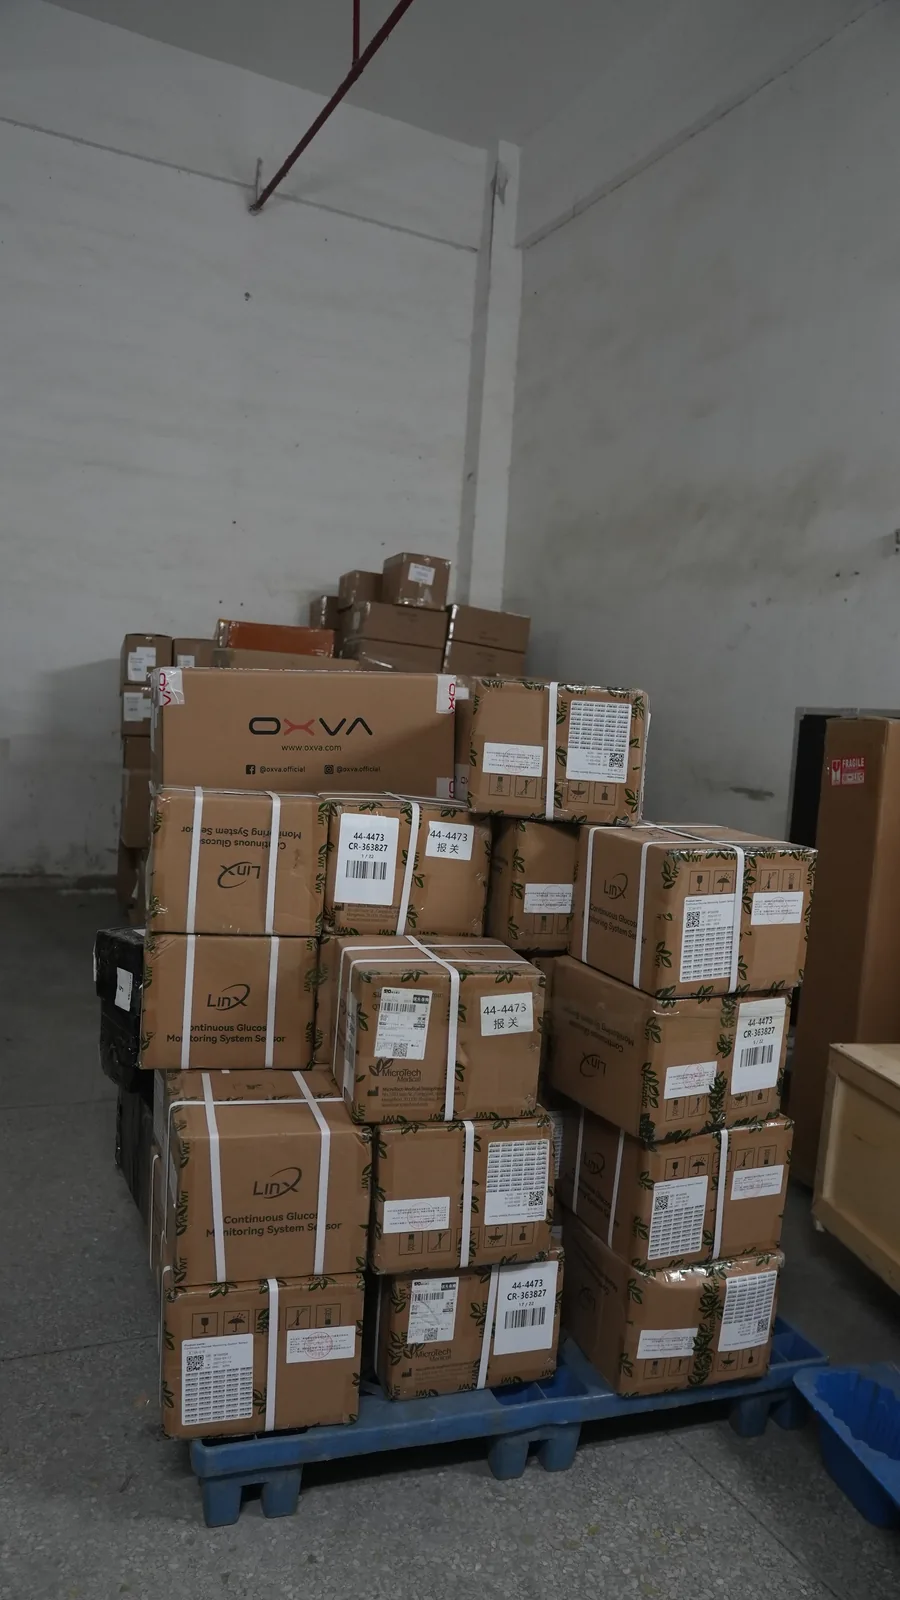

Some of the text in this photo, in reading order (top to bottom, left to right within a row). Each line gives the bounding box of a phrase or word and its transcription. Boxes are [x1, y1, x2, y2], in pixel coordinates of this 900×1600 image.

[248, 717, 373, 736] OXVA
[281, 743, 342, 751] www.oxva.com
[842, 757, 865, 768] FRAGILE
[259, 766, 306, 774] @oxva.official
[336, 766, 381, 774] @oxva.official
[215, 827, 249, 837] System
[251, 827, 302, 839] Moniring
[353, 832, 385, 841] 44-4473
[430, 830, 468, 842] 44-4473
[200, 838, 232, 848] Glucos
[348, 842, 388, 852] CR-363827
[437, 843, 459, 854] 报关
[618, 914, 637, 927] Glucos
[482, 1002, 527, 1015] 44-4473
[493, 1017, 519, 1030] 报关
[747, 1016, 773, 1027] 44-4473
[743, 1026, 775, 1038] CR-363827
[166, 1034, 217, 1044] Motoring
[220, 1034, 253, 1044] System
[381, 1069, 422, 1077] MicroTech
[223, 1214, 284, 1224] Continuous
[206, 1227, 264, 1238] Mnitoring
[267, 1225, 304, 1235] System
[511, 1279, 543, 1289] 44-4473
[506, 1289, 547, 1300] CR-363827
[415, 1348, 451, 1358] MicroTech
